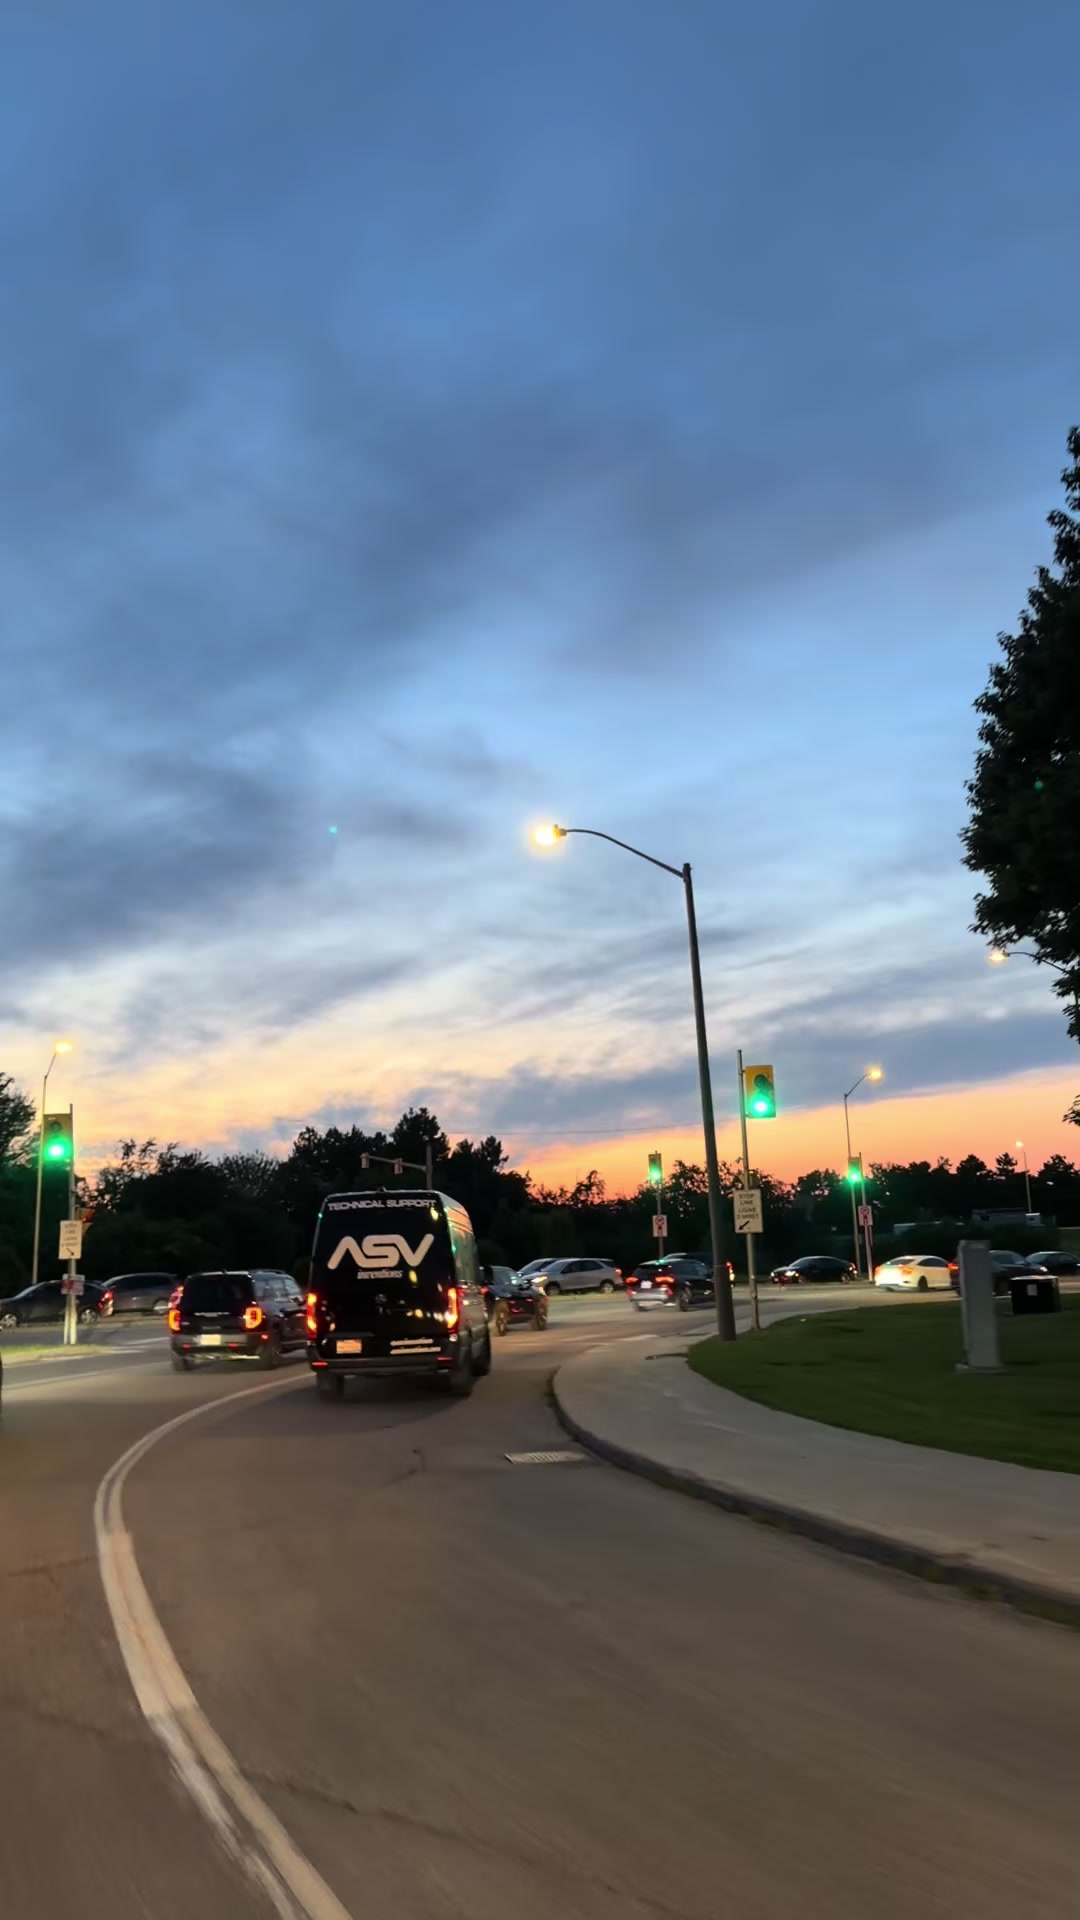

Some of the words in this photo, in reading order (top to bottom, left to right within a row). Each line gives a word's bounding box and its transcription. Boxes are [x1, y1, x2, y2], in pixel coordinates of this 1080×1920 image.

[328, 1200, 385, 1211] TECHNICAL
[386, 1199, 436, 1209] SUPPORT
[327, 1233, 434, 1270] ASV
